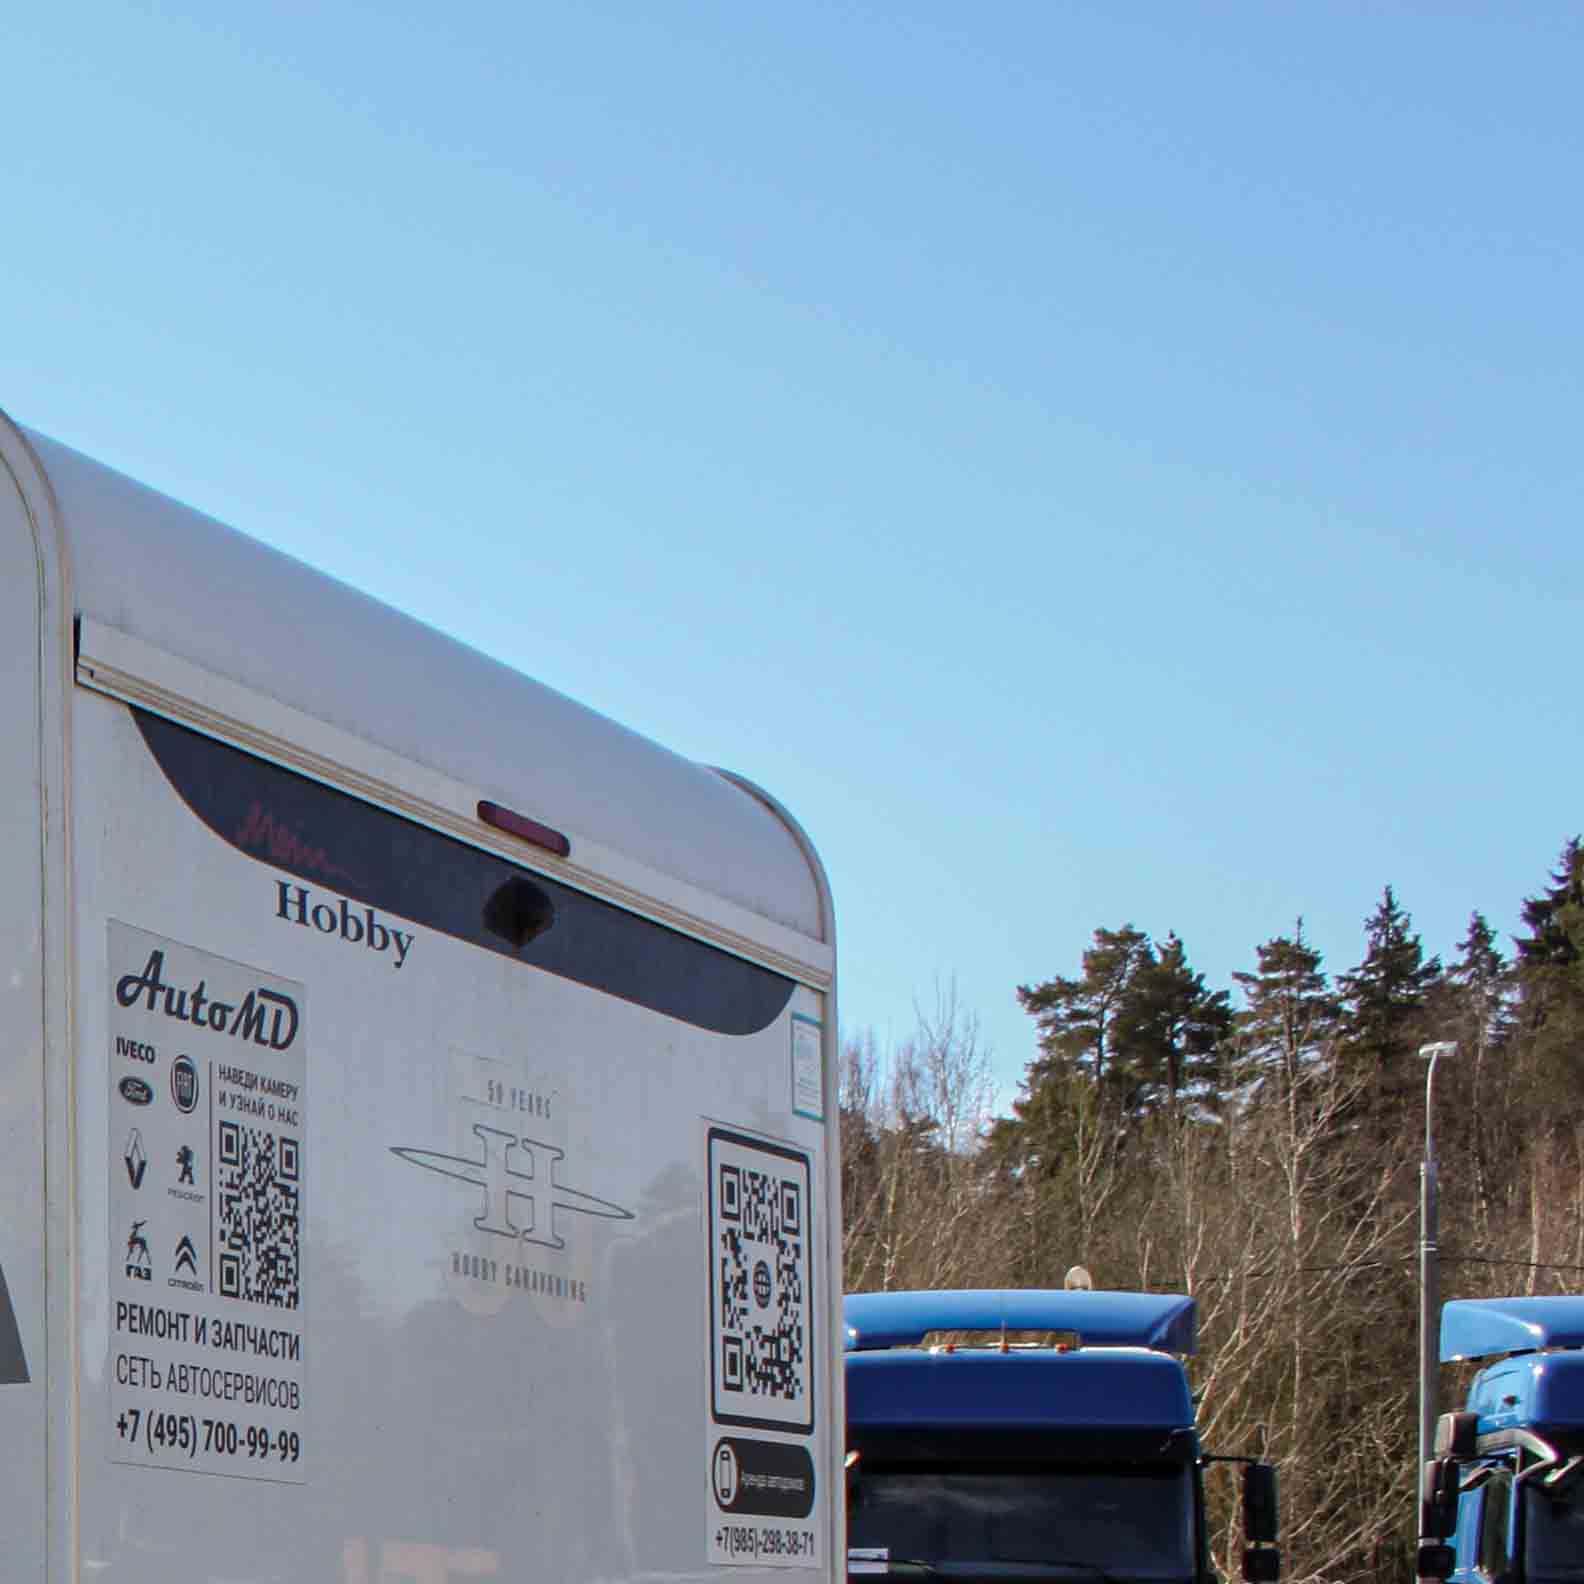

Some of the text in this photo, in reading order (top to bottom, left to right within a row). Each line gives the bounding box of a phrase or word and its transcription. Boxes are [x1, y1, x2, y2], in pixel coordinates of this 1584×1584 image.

[274, 879, 415, 968] Hobby
[116, 949, 299, 1050] AutoMD
[116, 1036, 155, 1064] IVECO
[219, 1063, 299, 1101] НАВЕДИ КАМЕРУ
[219, 1092, 299, 1127] И УЗНАЙ О НАС
[126, 1264, 153, 1281] ГАЗ
[116, 1301, 300, 1361] РЕМОНТ И ЗАПЧАСТИ
[116, 1354, 300, 1410] СЕТЬ АВТОСЕРВИСОВ
[116, 1409, 300, 1463] +7 (495) 700-99-99
